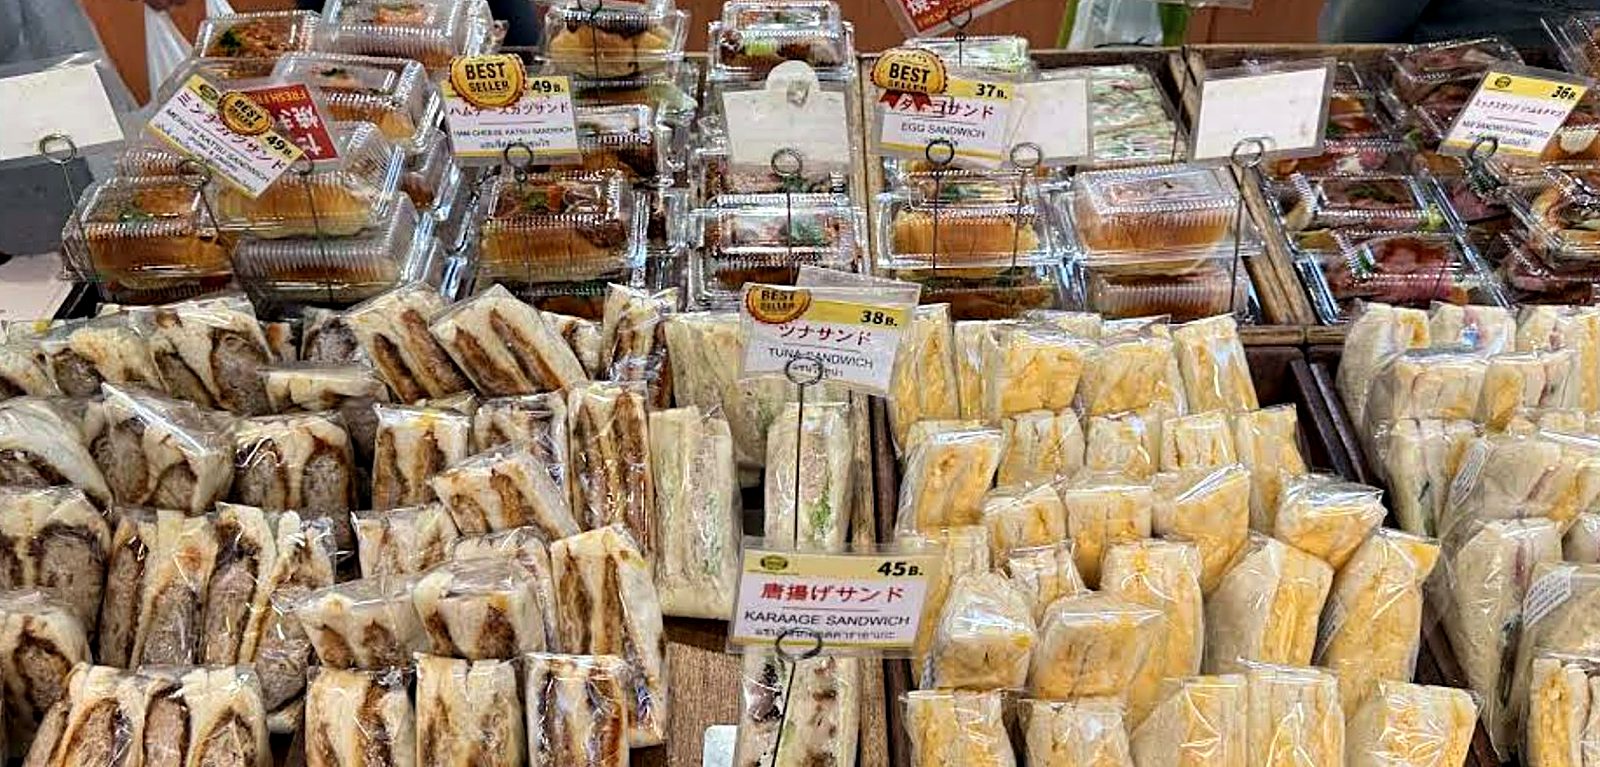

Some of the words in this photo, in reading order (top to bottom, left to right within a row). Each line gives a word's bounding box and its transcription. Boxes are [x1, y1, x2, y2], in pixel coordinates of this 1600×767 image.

[465, 62, 505, 80] BEST
[889, 63, 930, 83] BEST
[469, 80, 509, 93] SELLER
[234, 99, 263, 123] BEST
[901, 122, 925, 133] EGG
[927, 125, 985, 139] SANDWICH
[761, 290, 795, 301] BEST
[860, 310, 898, 327] 38B.
[779, 325, 871, 345] ツナサンド
[769, 347, 801, 359] TUNA
[877, 561, 924, 577] 45B.
[760, 582, 904, 602] 唐揚げサンド
[744, 610, 821, 626] KARAAGE
[825, 615, 911, 627] SANDWICH
